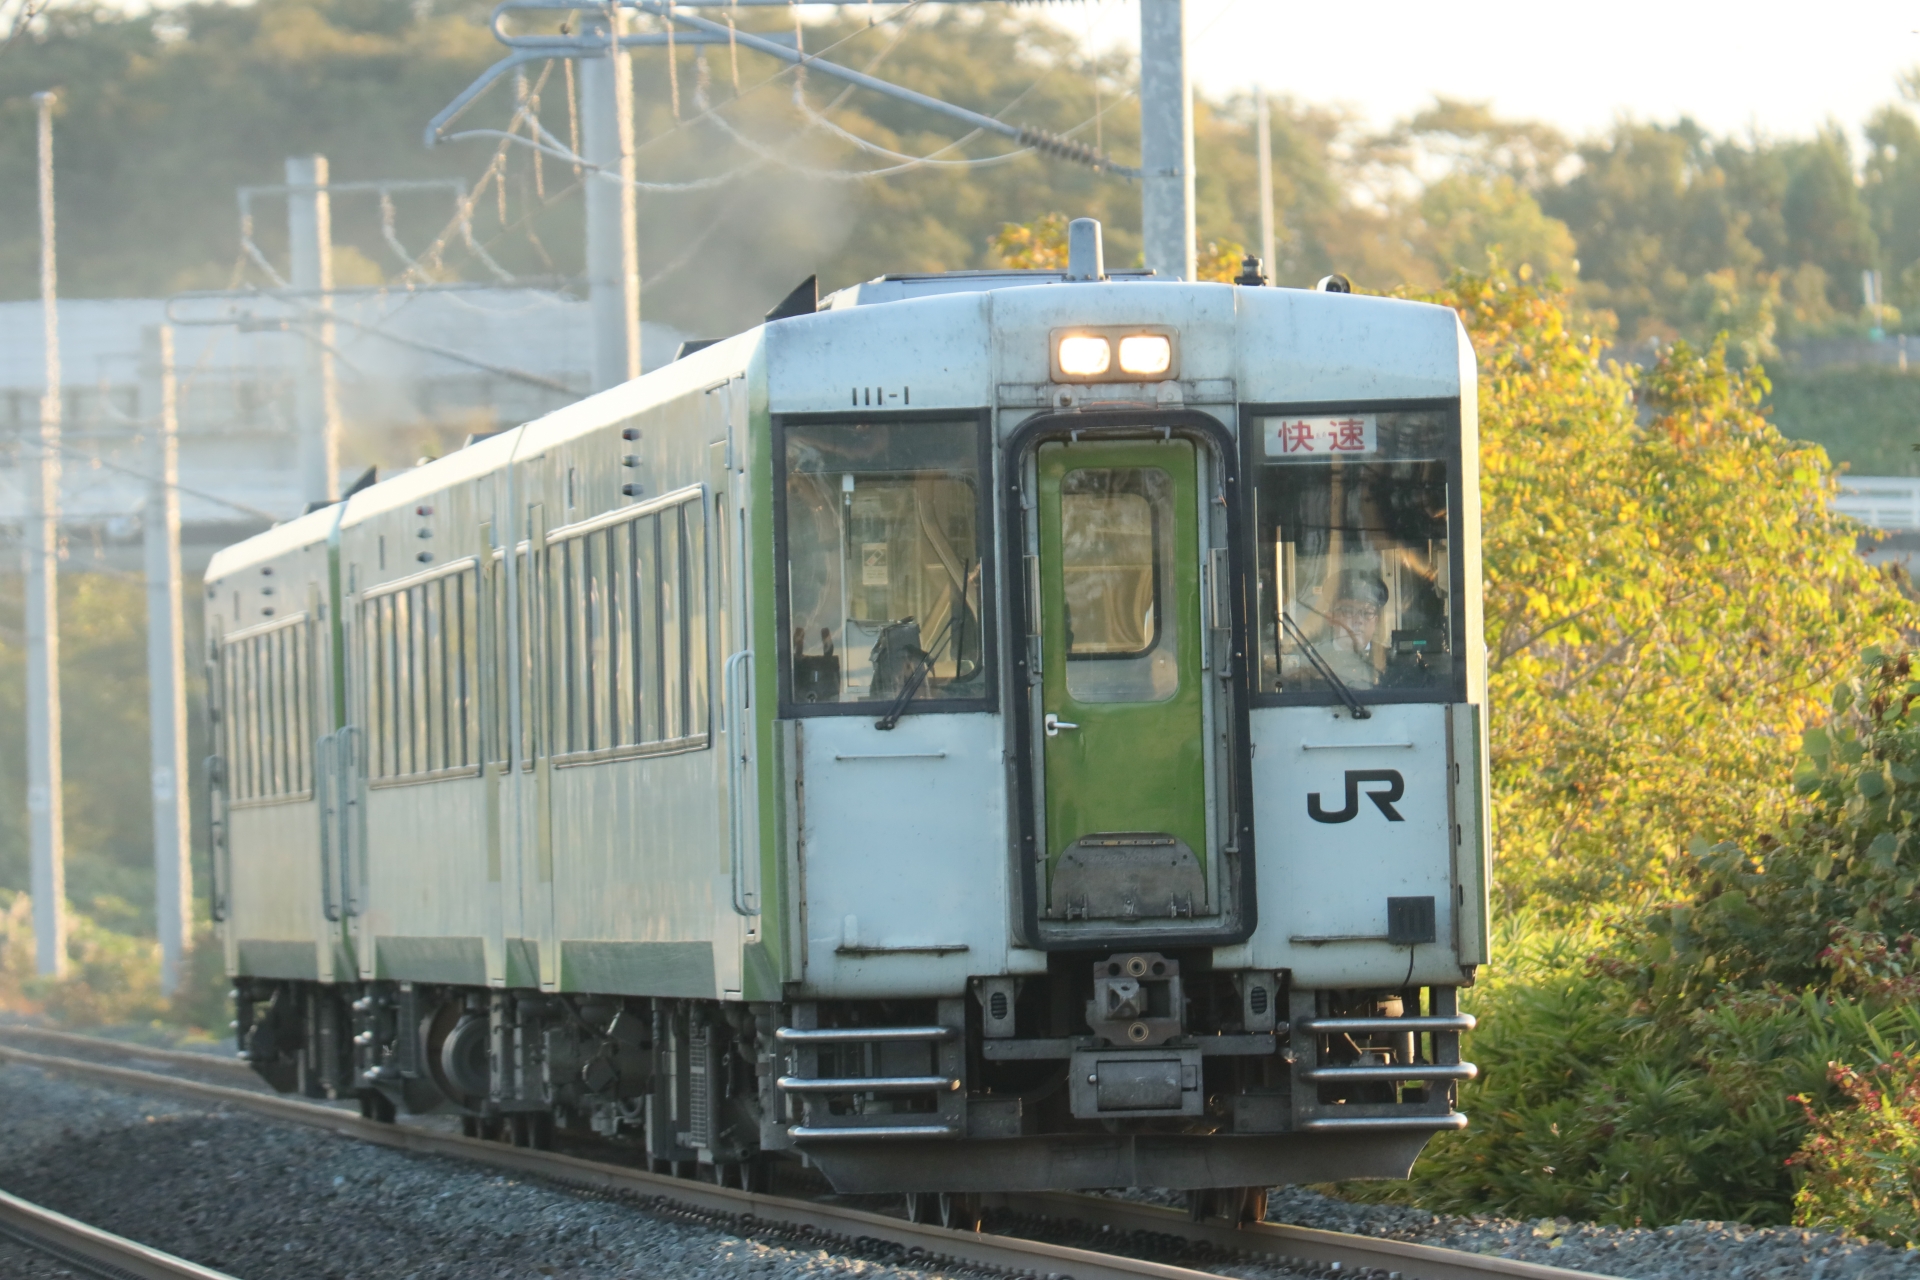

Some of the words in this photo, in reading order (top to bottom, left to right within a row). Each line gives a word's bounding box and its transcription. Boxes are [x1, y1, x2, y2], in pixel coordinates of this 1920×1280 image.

[852, 386, 909, 406] 111-1
[1277, 418, 1365, 453] 快速
[1307, 769, 1405, 823] JR
